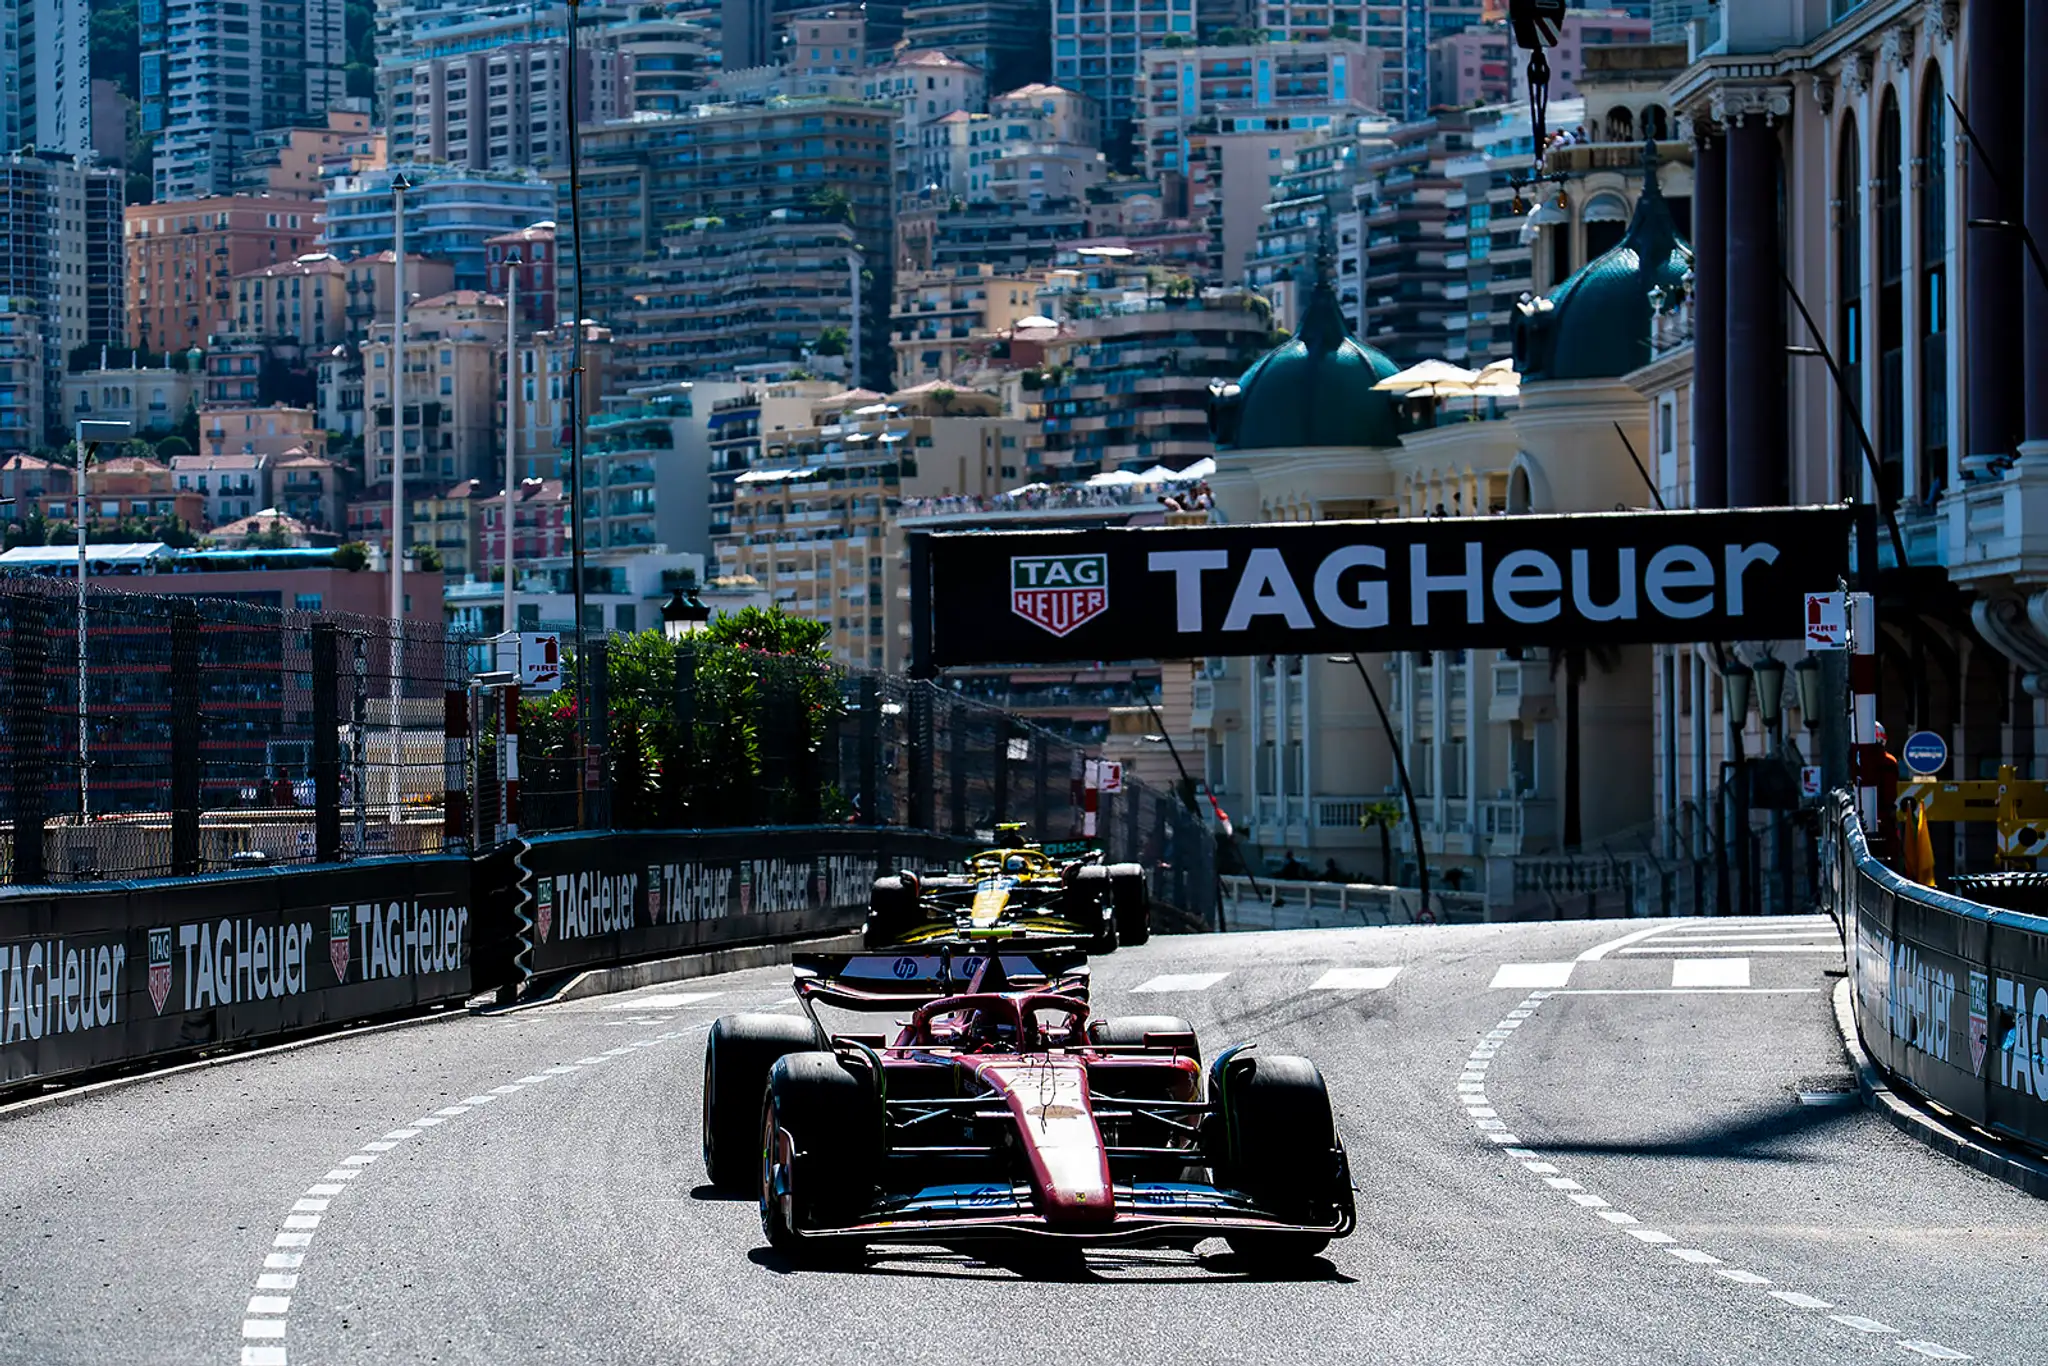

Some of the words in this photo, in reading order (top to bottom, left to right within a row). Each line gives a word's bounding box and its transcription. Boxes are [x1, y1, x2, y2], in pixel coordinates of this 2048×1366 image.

[1018, 560, 1099, 585] TAG
[1017, 591, 1102, 631] HEUER
[1808, 624, 1838, 632] FIRE
[528, 664, 558, 672] FIRE
[332, 911, 348, 934] TAG
[150, 934, 169, 960] TAG
[896, 957, 916, 980] hp
